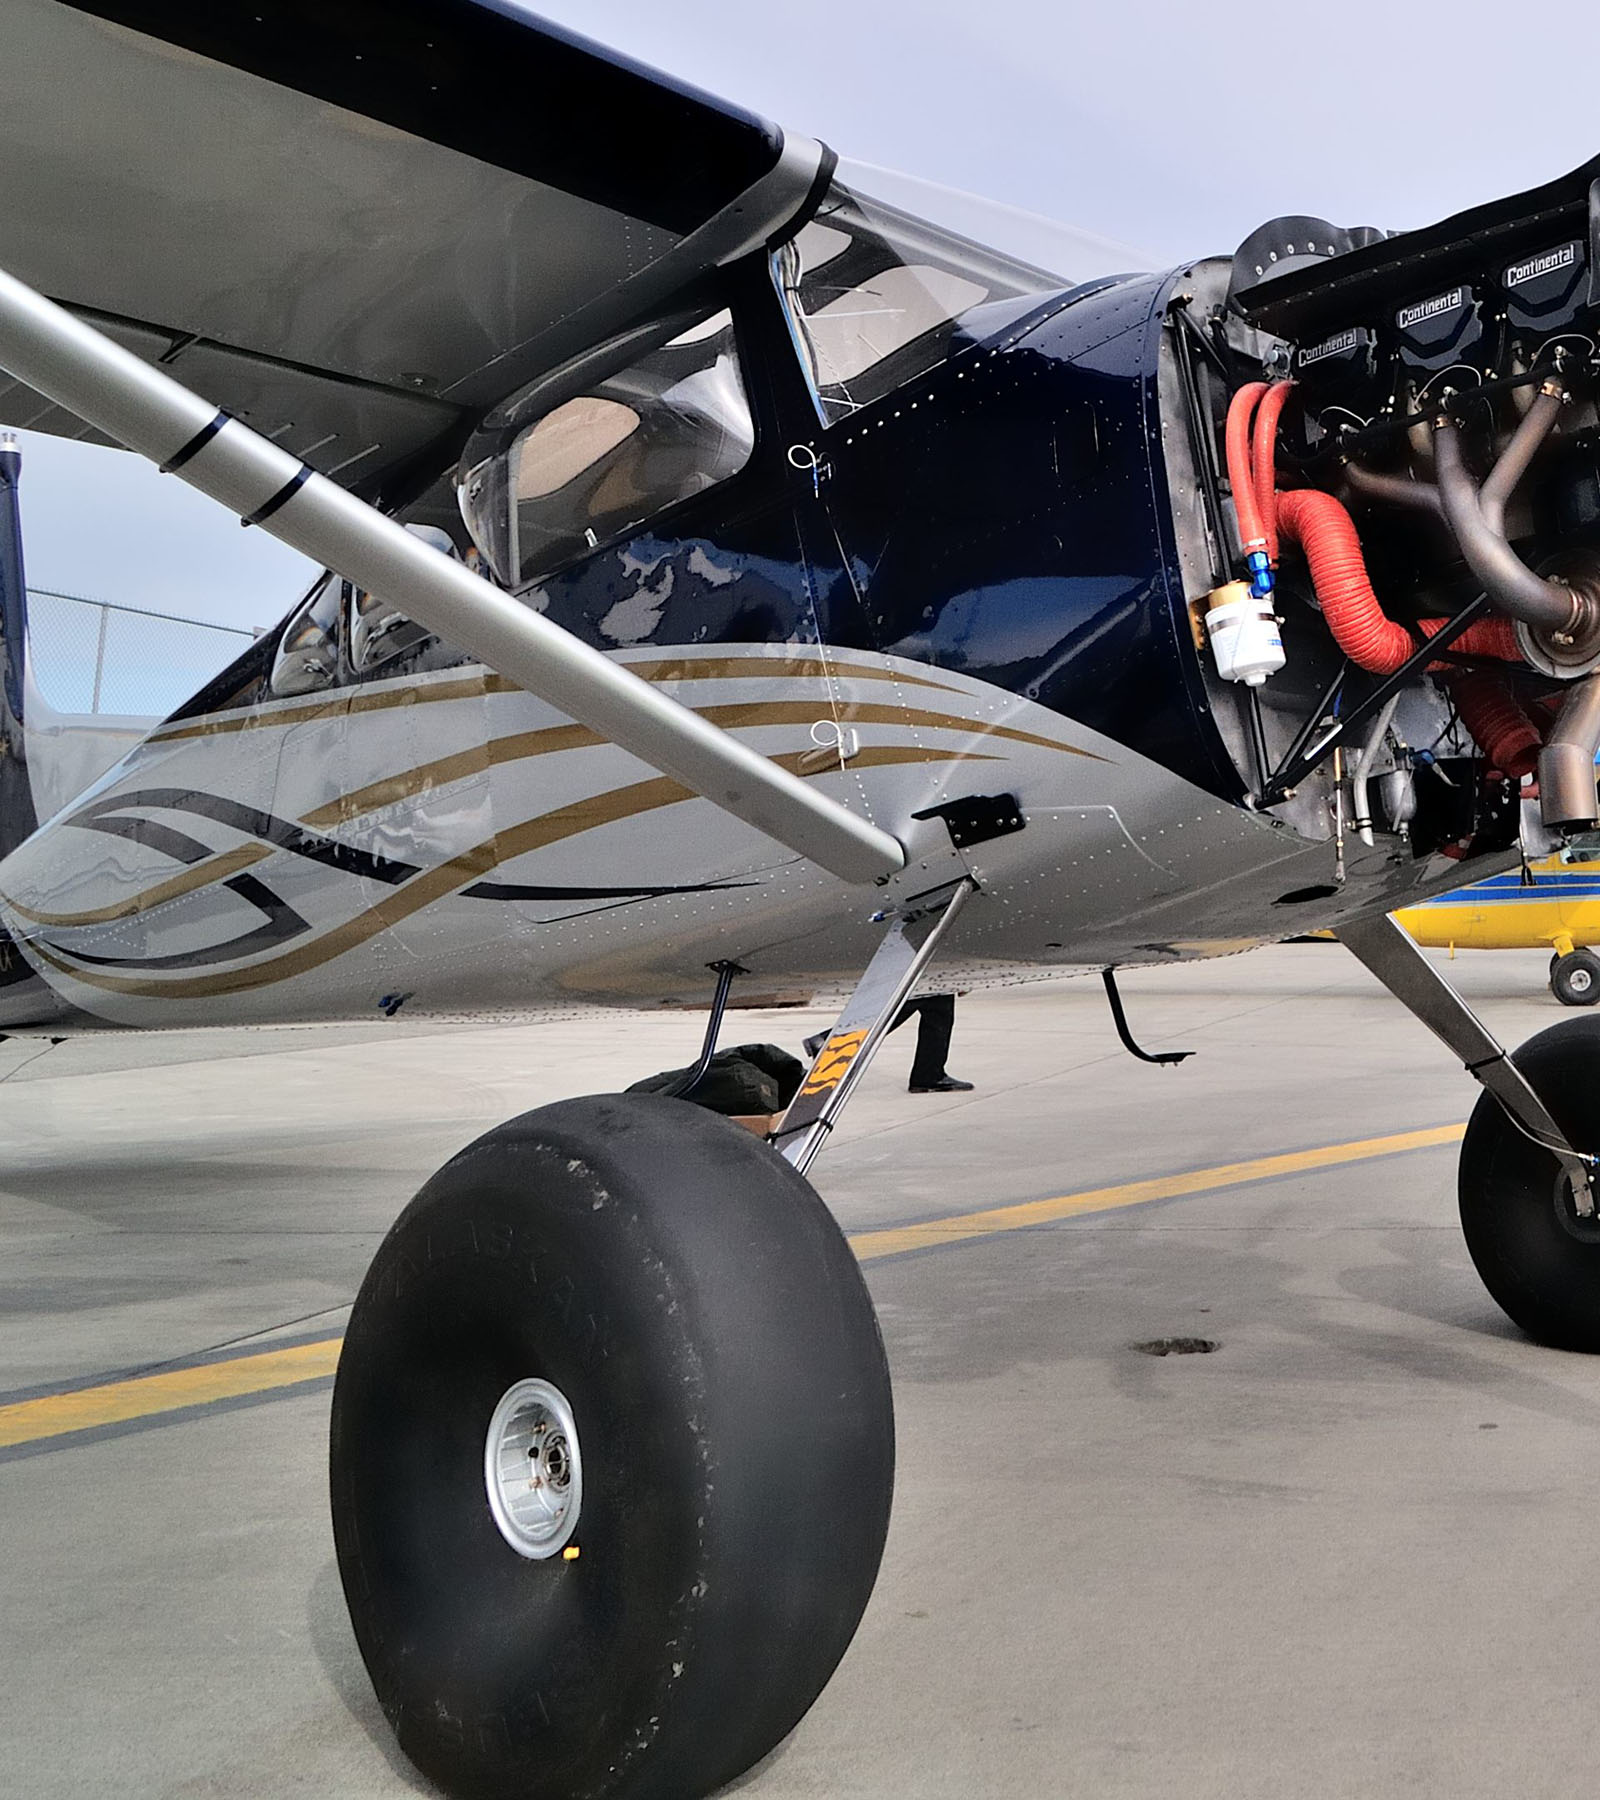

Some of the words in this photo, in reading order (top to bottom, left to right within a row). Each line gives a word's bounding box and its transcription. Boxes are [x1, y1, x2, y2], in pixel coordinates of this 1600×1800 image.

[1507, 244, 1574, 287] Continental
[1399, 287, 1462, 328] Continental
[1298, 328, 1357, 367] Continental
